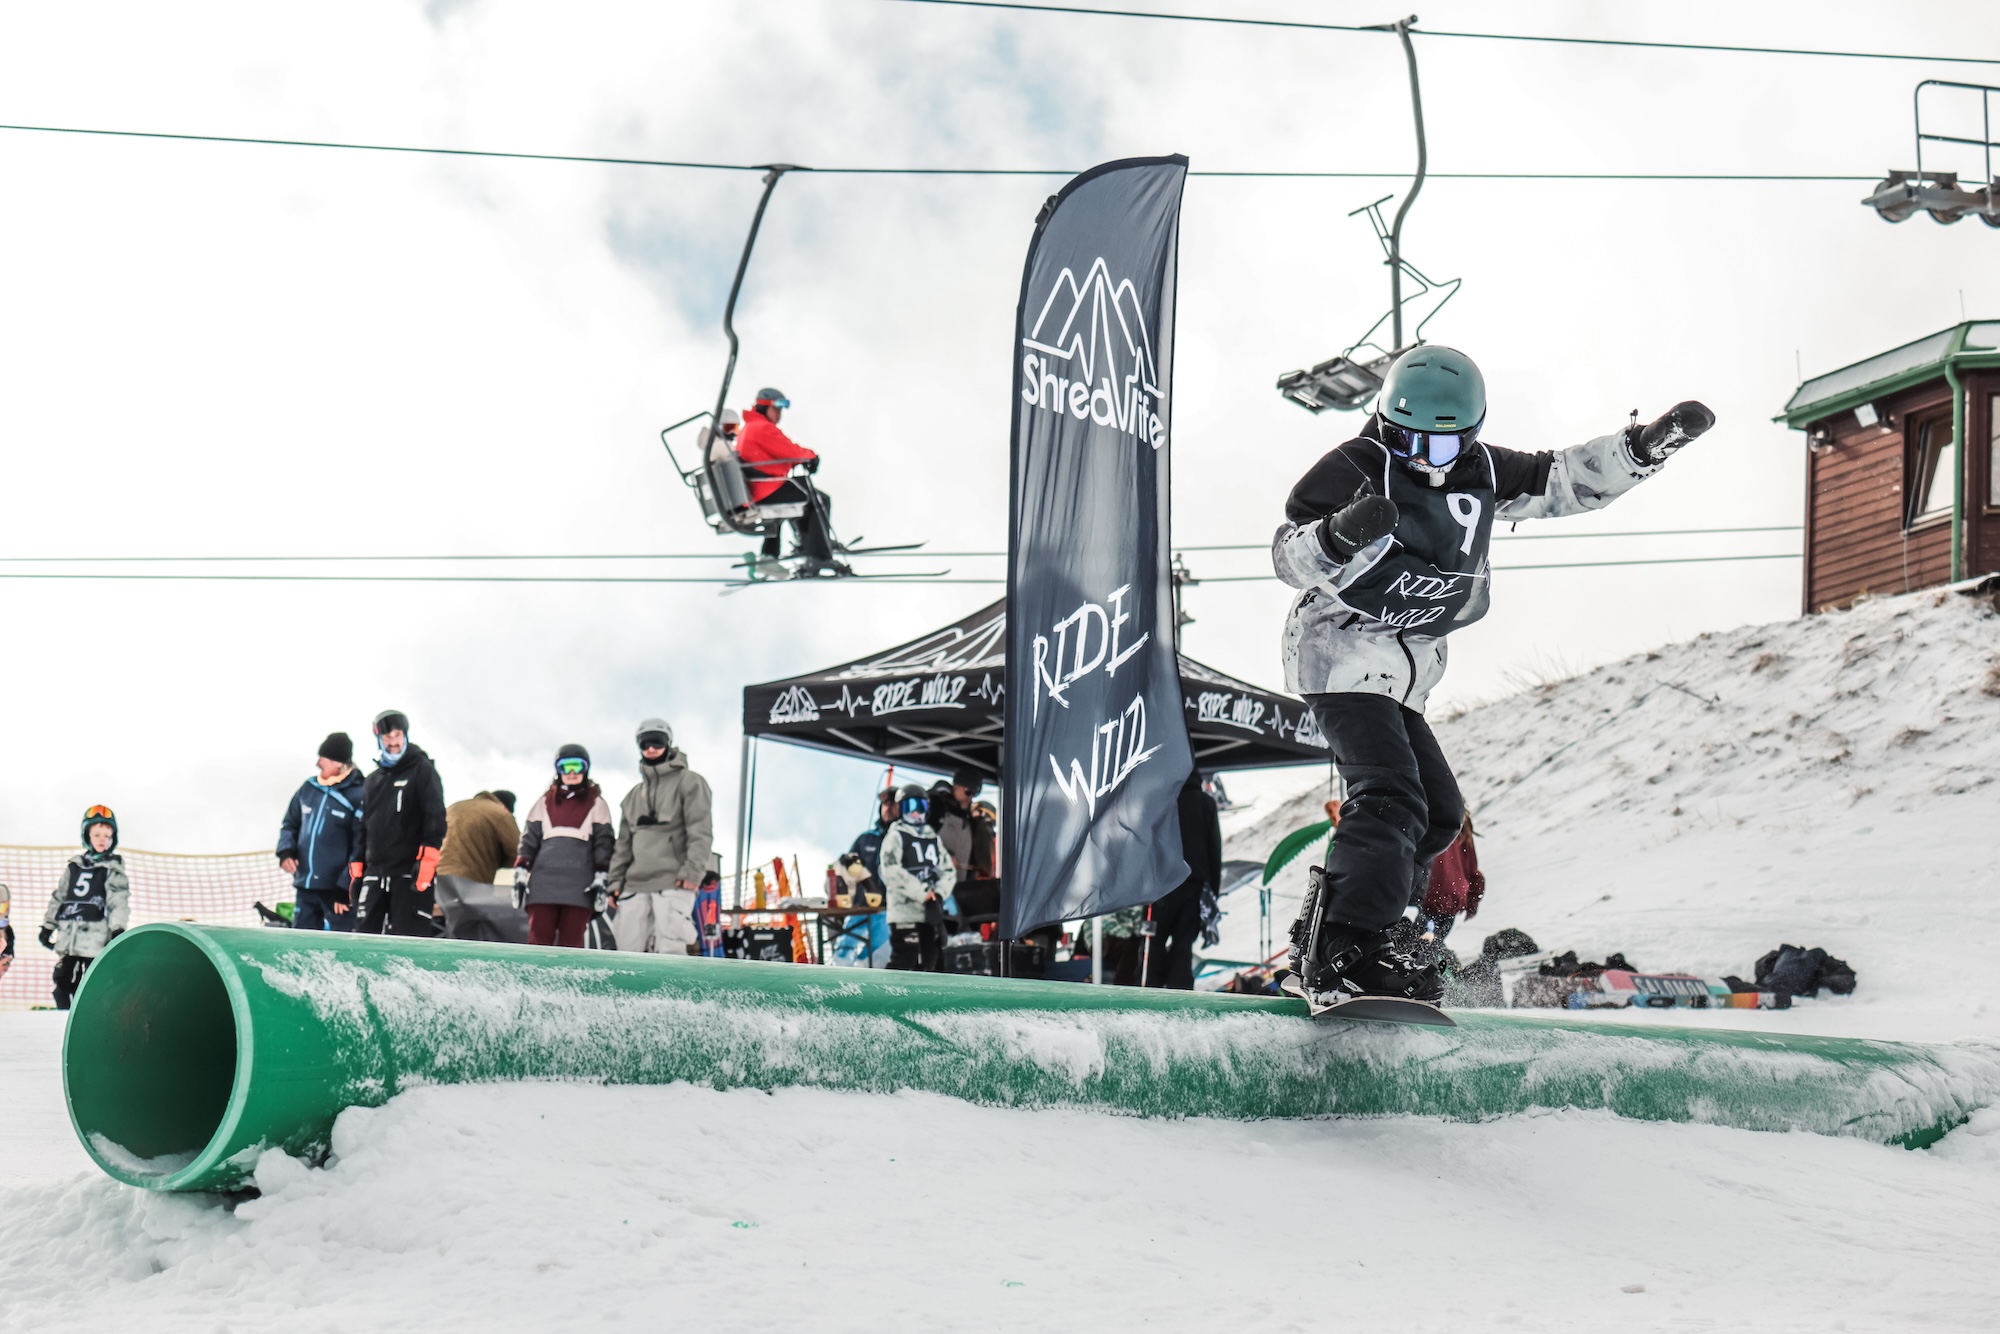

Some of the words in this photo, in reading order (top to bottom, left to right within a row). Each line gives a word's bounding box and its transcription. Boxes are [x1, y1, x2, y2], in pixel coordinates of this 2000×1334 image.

[1446, 493, 1482, 556] 9
[1384, 570, 1463, 601] RIDE
[1380, 605, 1446, 629] WILD
[1033, 583, 1149, 728] RIDE
[871, 678, 920, 713] RIDE
[922, 673, 966, 706] WILD
[1198, 692, 1232, 720] RIDE
[1232, 693, 1265, 726] WILD
[1050, 692, 1163, 821] WILD
[912, 841, 938, 867] 14
[73, 872, 93, 897] 5
[1634, 977, 1710, 996] SALOMON
